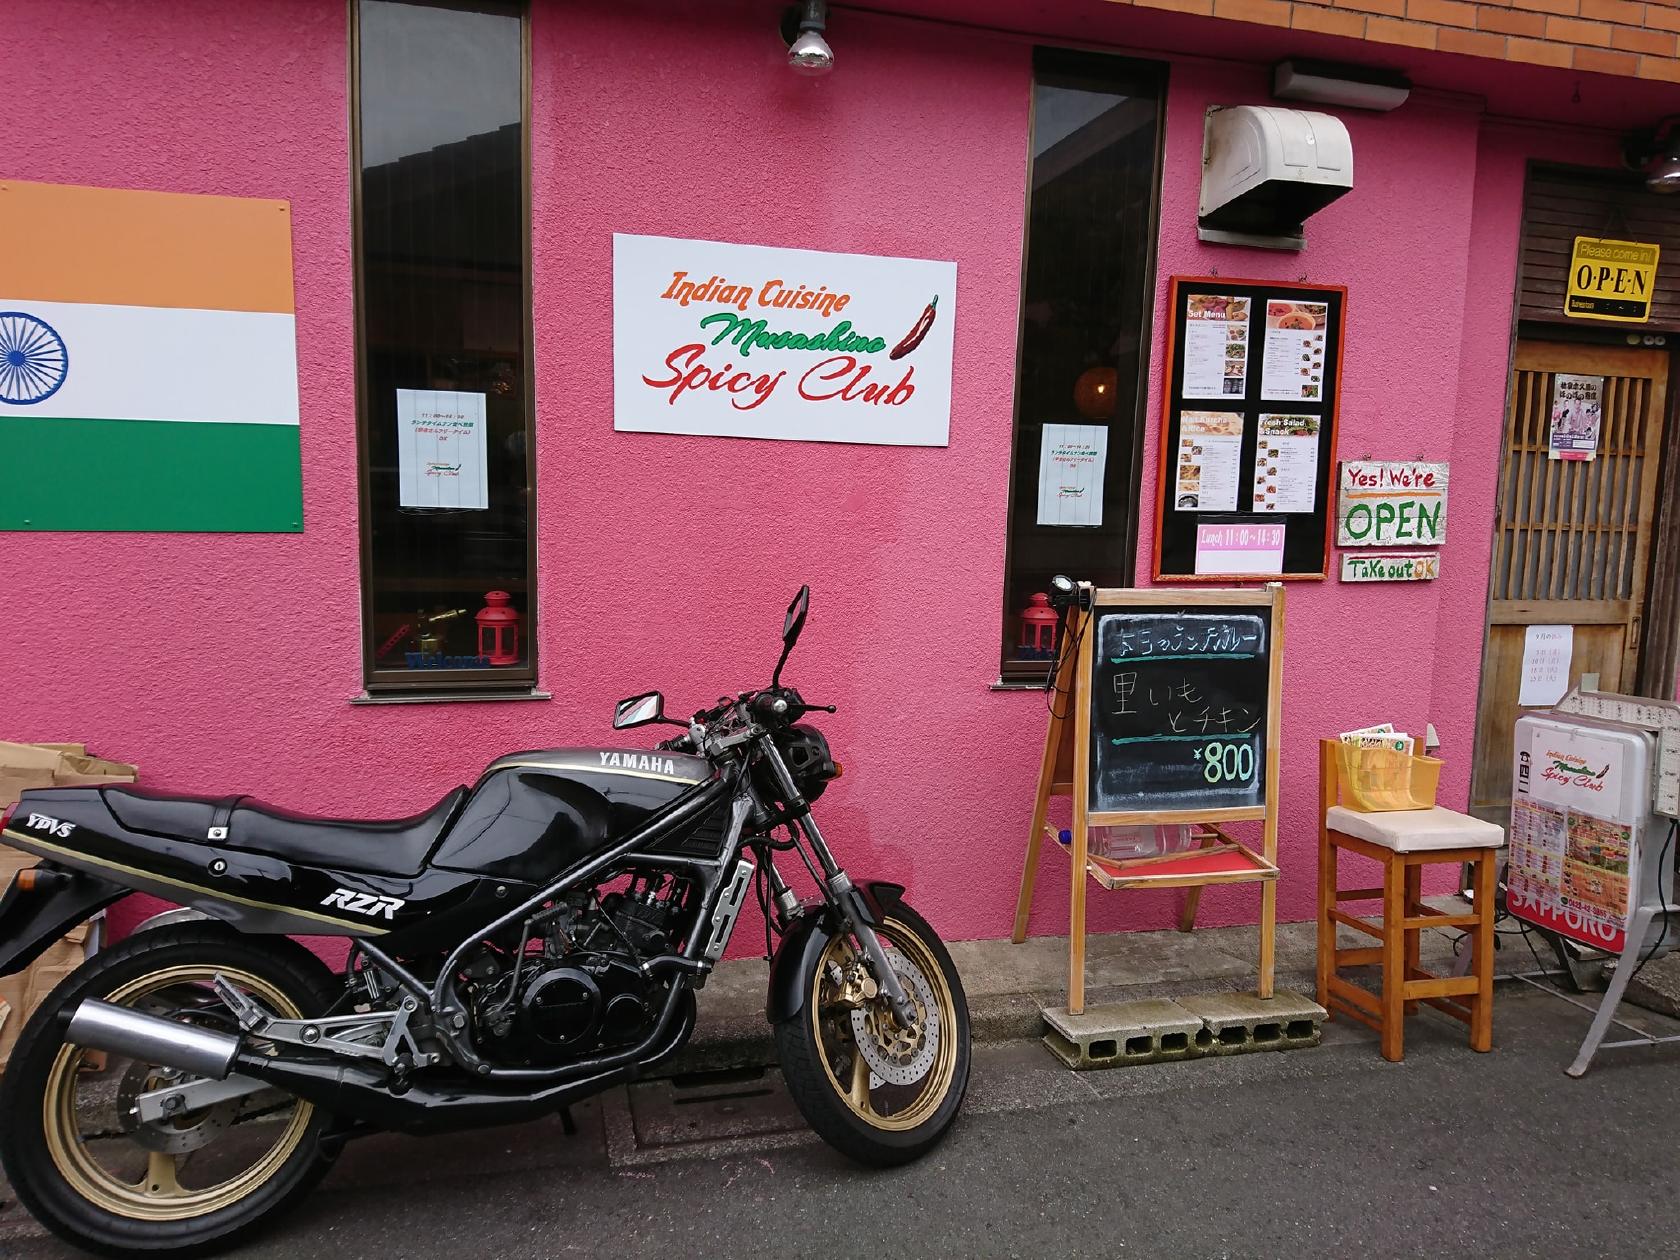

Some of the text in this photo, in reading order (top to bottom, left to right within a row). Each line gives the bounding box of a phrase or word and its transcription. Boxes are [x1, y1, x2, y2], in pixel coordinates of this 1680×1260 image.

[1580, 244, 1611, 258] Please
[1612, 250, 1640, 261] come
[660, 271, 851, 318] Indian Cuisine
[700, 312, 887, 357] Musashino
[641, 343, 915, 410] Spicy Club
[1348, 468, 1436, 488] Yes! We're
[1345, 501, 1441, 541] OPEN
[1200, 528, 1223, 547] Lunch
[1414, 560, 1435, 578] OK
[1112, 672, 1205, 715] 里いも
[1168, 705, 1262, 733] とチキン
[599, 751, 675, 775] YAMAHA
[1541, 767, 1604, 792] Spicy Club
[25, 812, 76, 838] YPVS
[320, 887, 406, 920] RZR
